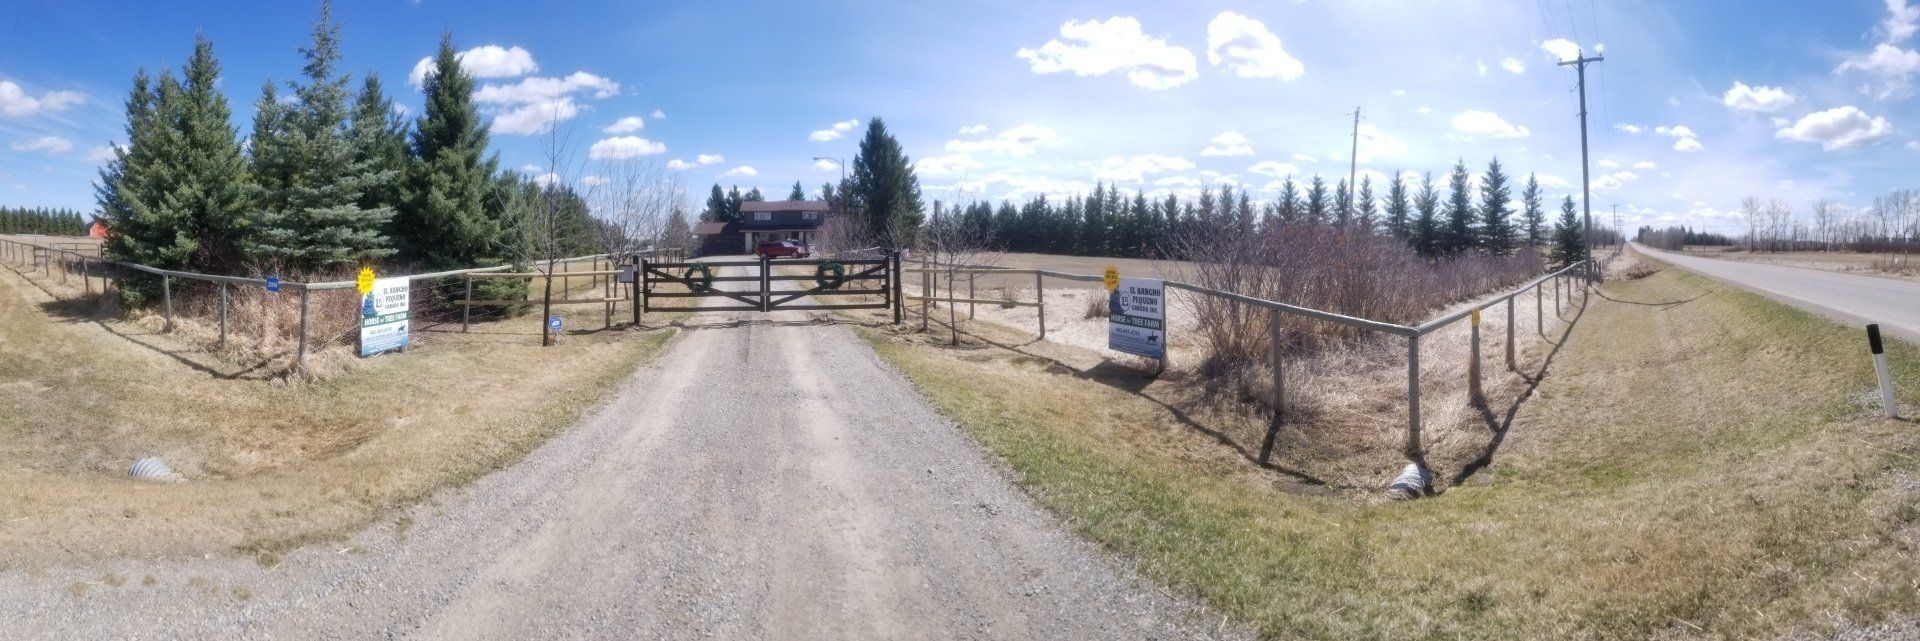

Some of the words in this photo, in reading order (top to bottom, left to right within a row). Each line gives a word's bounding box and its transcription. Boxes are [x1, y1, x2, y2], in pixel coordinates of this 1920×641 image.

[1137, 288, 1161, 297] RANCHO
[364, 317, 379, 326] HORSE
[385, 314, 395, 323] TREE
[1110, 313, 1126, 323] HORSE
[1132, 317, 1144, 326] TREE
[1144, 319, 1160, 329] FARM
